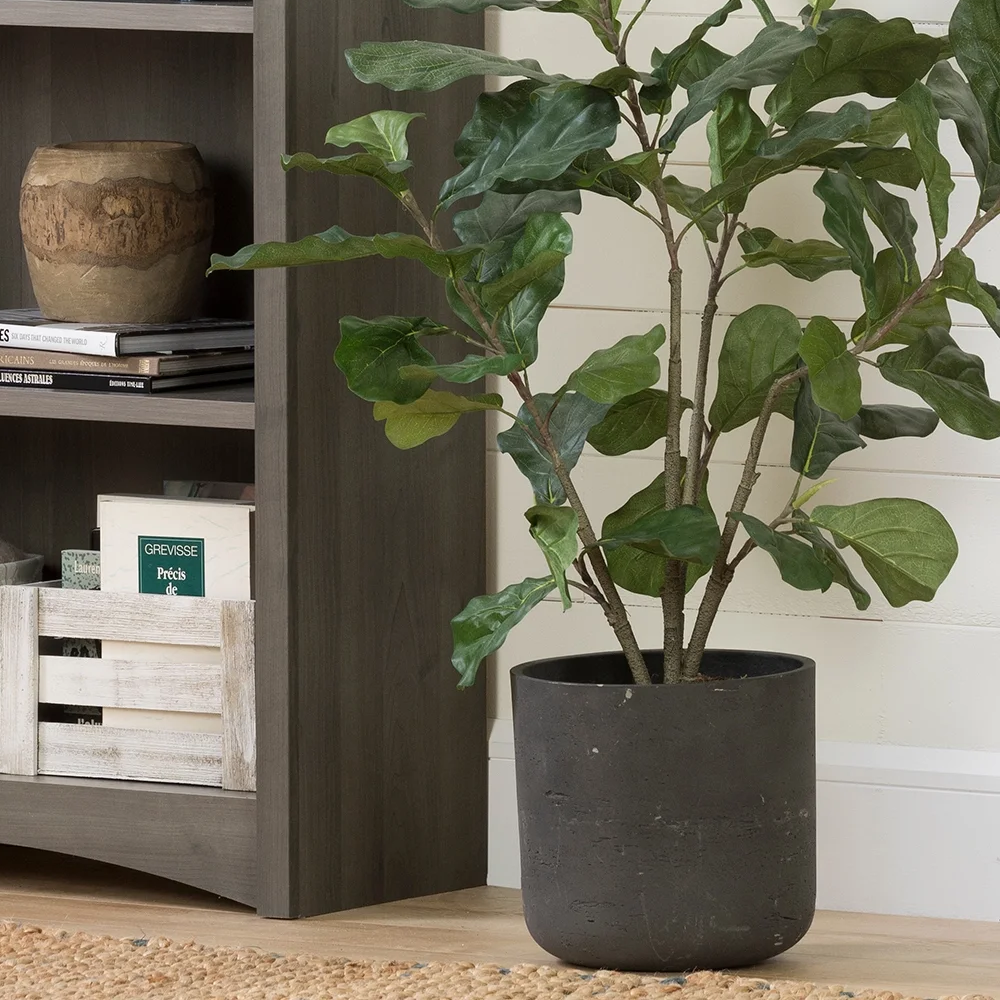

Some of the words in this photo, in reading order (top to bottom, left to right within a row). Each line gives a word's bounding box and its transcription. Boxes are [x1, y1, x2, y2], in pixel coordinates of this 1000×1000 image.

[11, 332, 19, 340] SIX
[19, 333, 31, 341] DAYS
[42, 335, 63, 344] CHANGED
[63, 337, 73, 345] THE
[72, 338, 88, 346] WORLD
[23, 374, 54, 385] ASTRALES
[144, 543, 199, 557] GREVISSE
[157, 566, 187, 581] Précis
[166, 582, 178, 596] de
